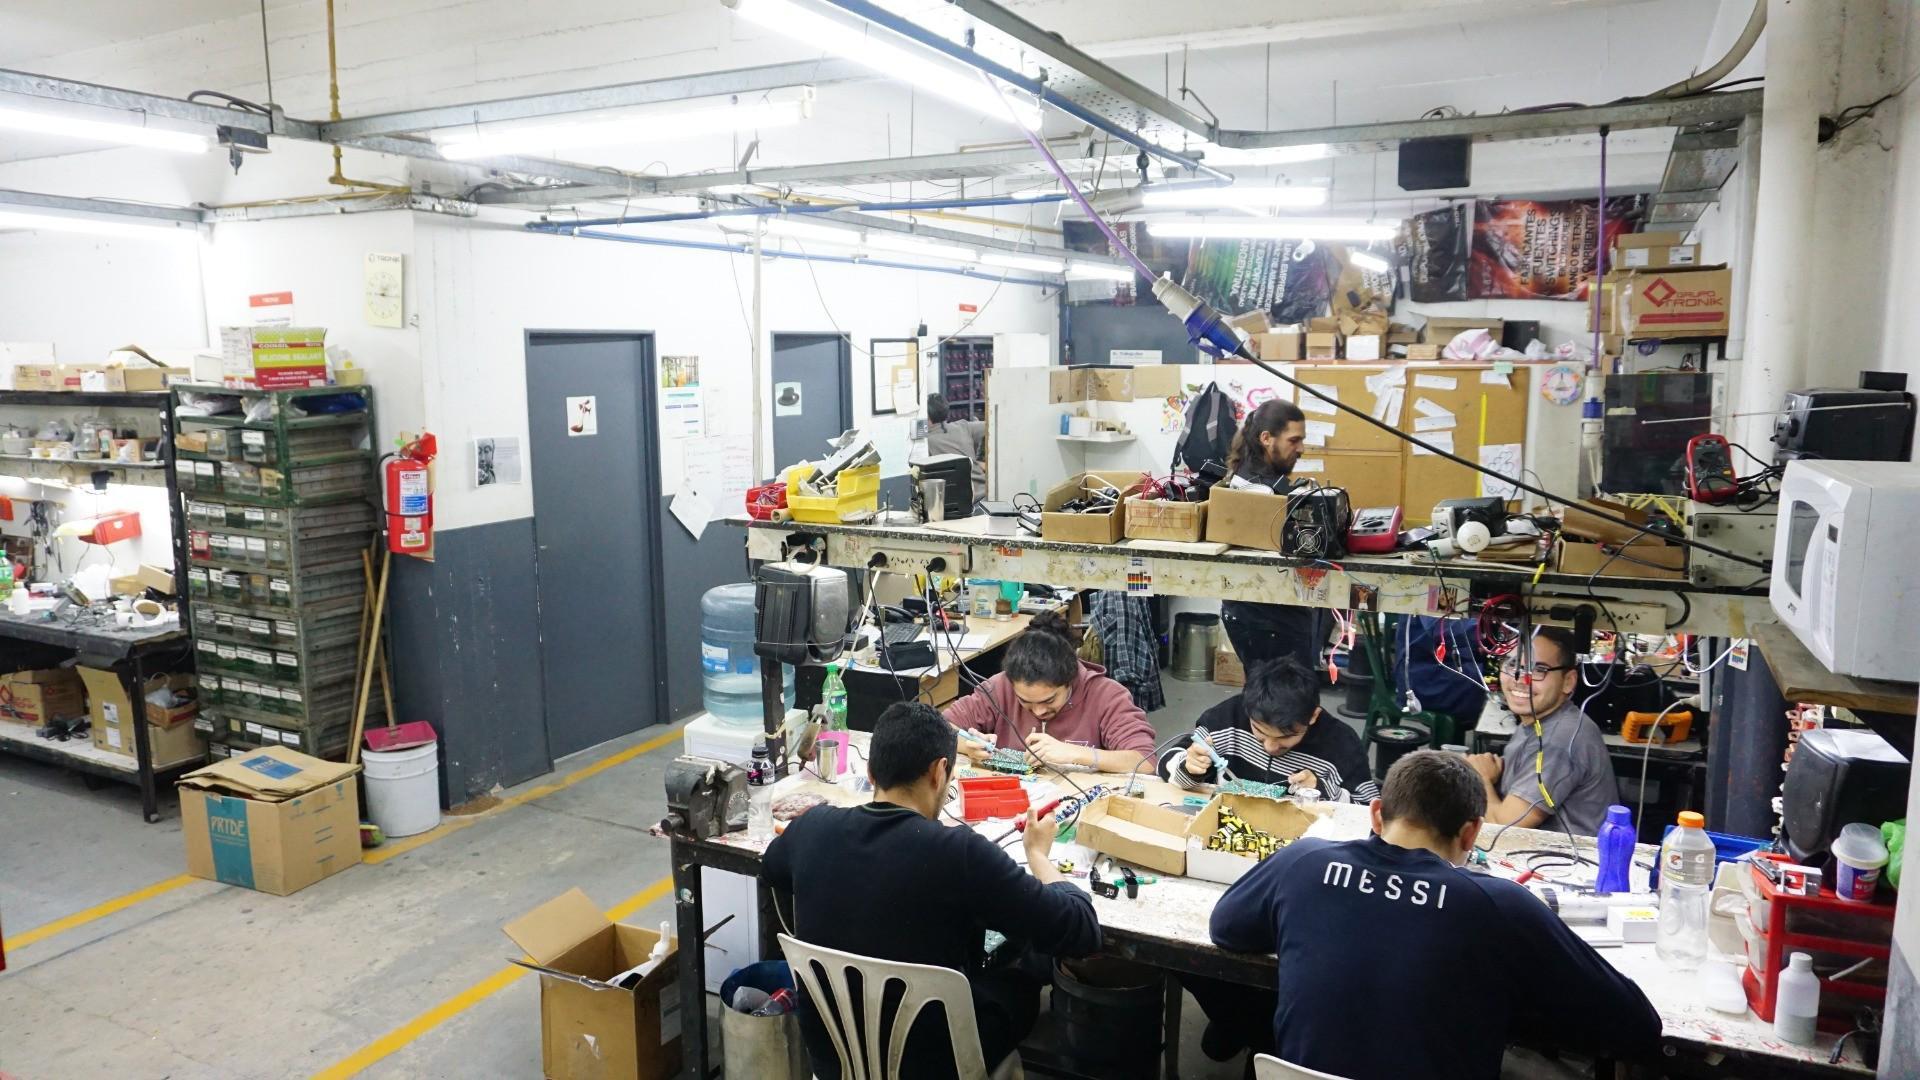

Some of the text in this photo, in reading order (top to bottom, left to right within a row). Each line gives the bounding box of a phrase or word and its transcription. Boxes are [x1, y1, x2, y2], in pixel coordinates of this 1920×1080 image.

[1520, 209, 1536, 286] FABRICANTES
[1533, 219, 1547, 276] FUENTES
[1546, 210, 1561, 286] SWITCHINGS
[1569, 242, 1581, 258] DE
[1247, 248, 1264, 301] EXPORTAR
[1274, 263, 1289, 304] EMPRESA
[1676, 290, 1716, 298] GRUPO
[1663, 297, 1724, 309] TRONIK
[1322, 860, 1448, 910] MESSI
